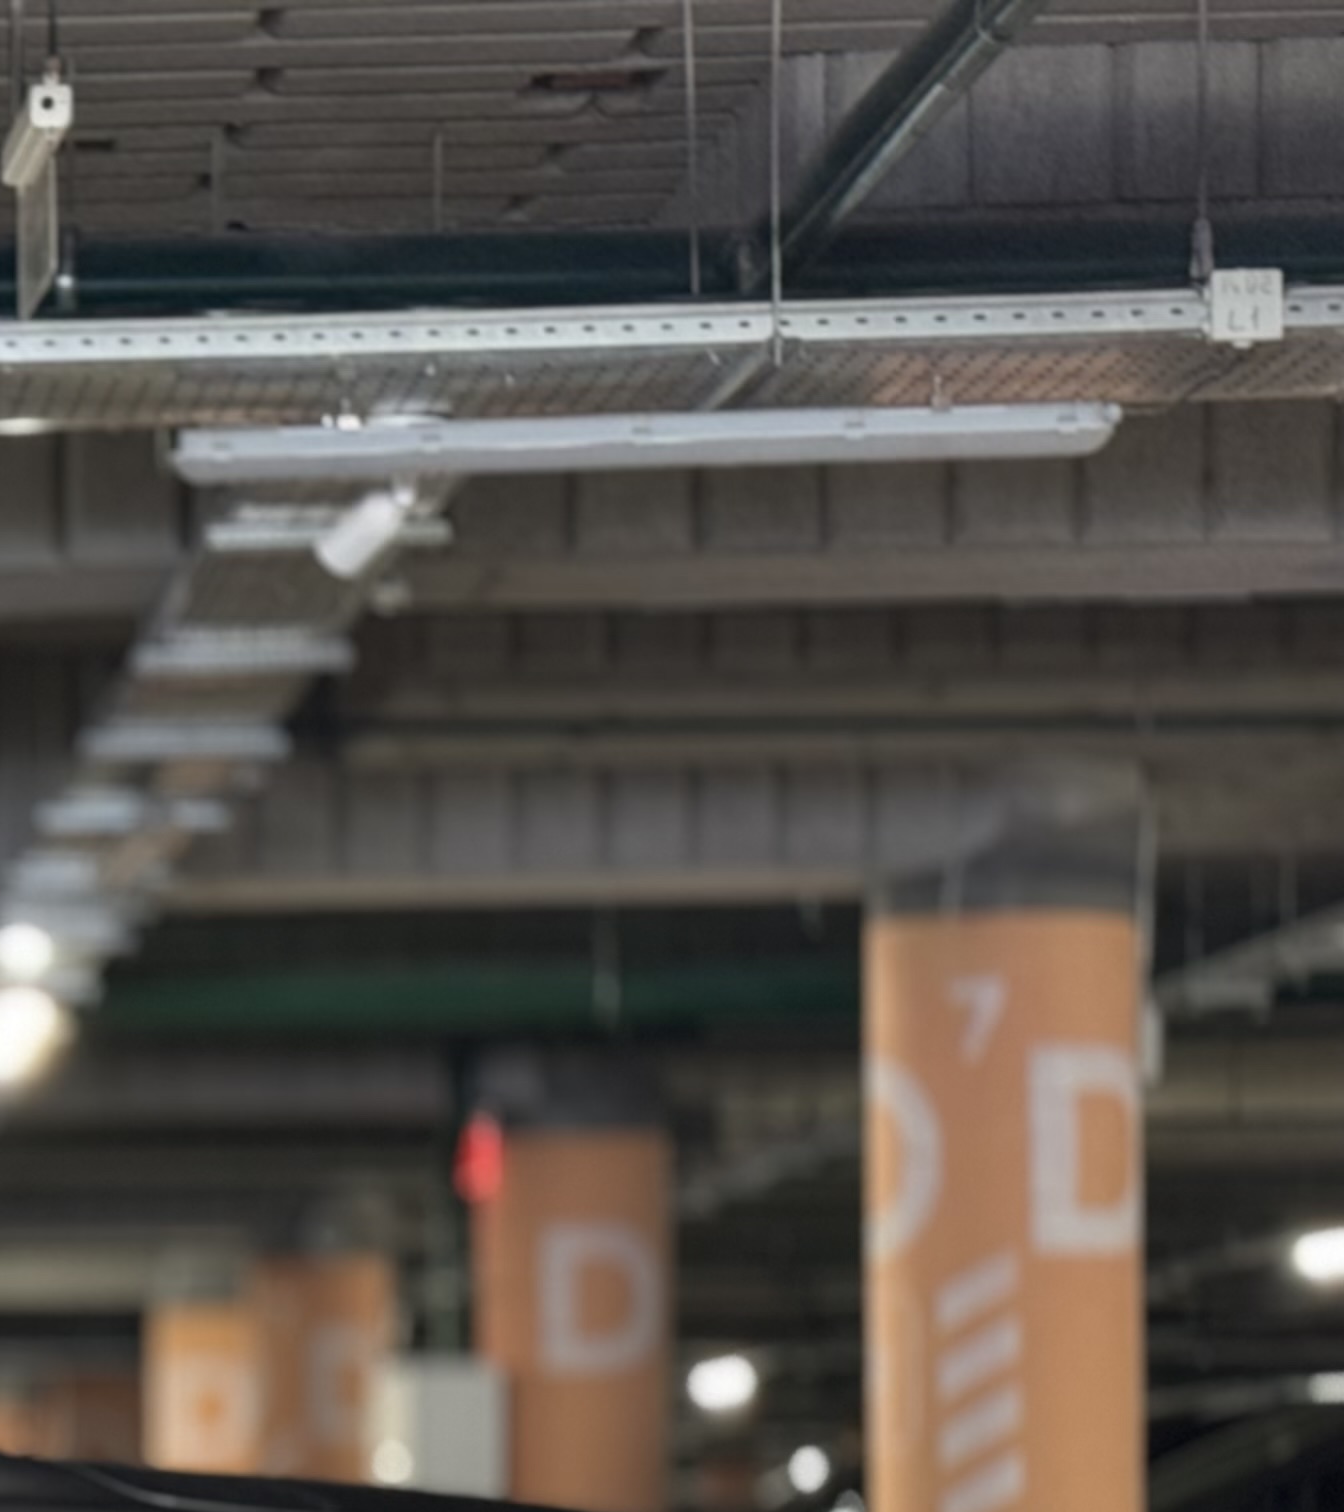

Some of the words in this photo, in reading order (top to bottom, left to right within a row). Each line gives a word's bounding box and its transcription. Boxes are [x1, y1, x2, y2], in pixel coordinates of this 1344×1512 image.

[948, 973, 1006, 1066] 7
[1028, 1041, 1142, 1257] D
[537, 1222, 663, 1378] D
